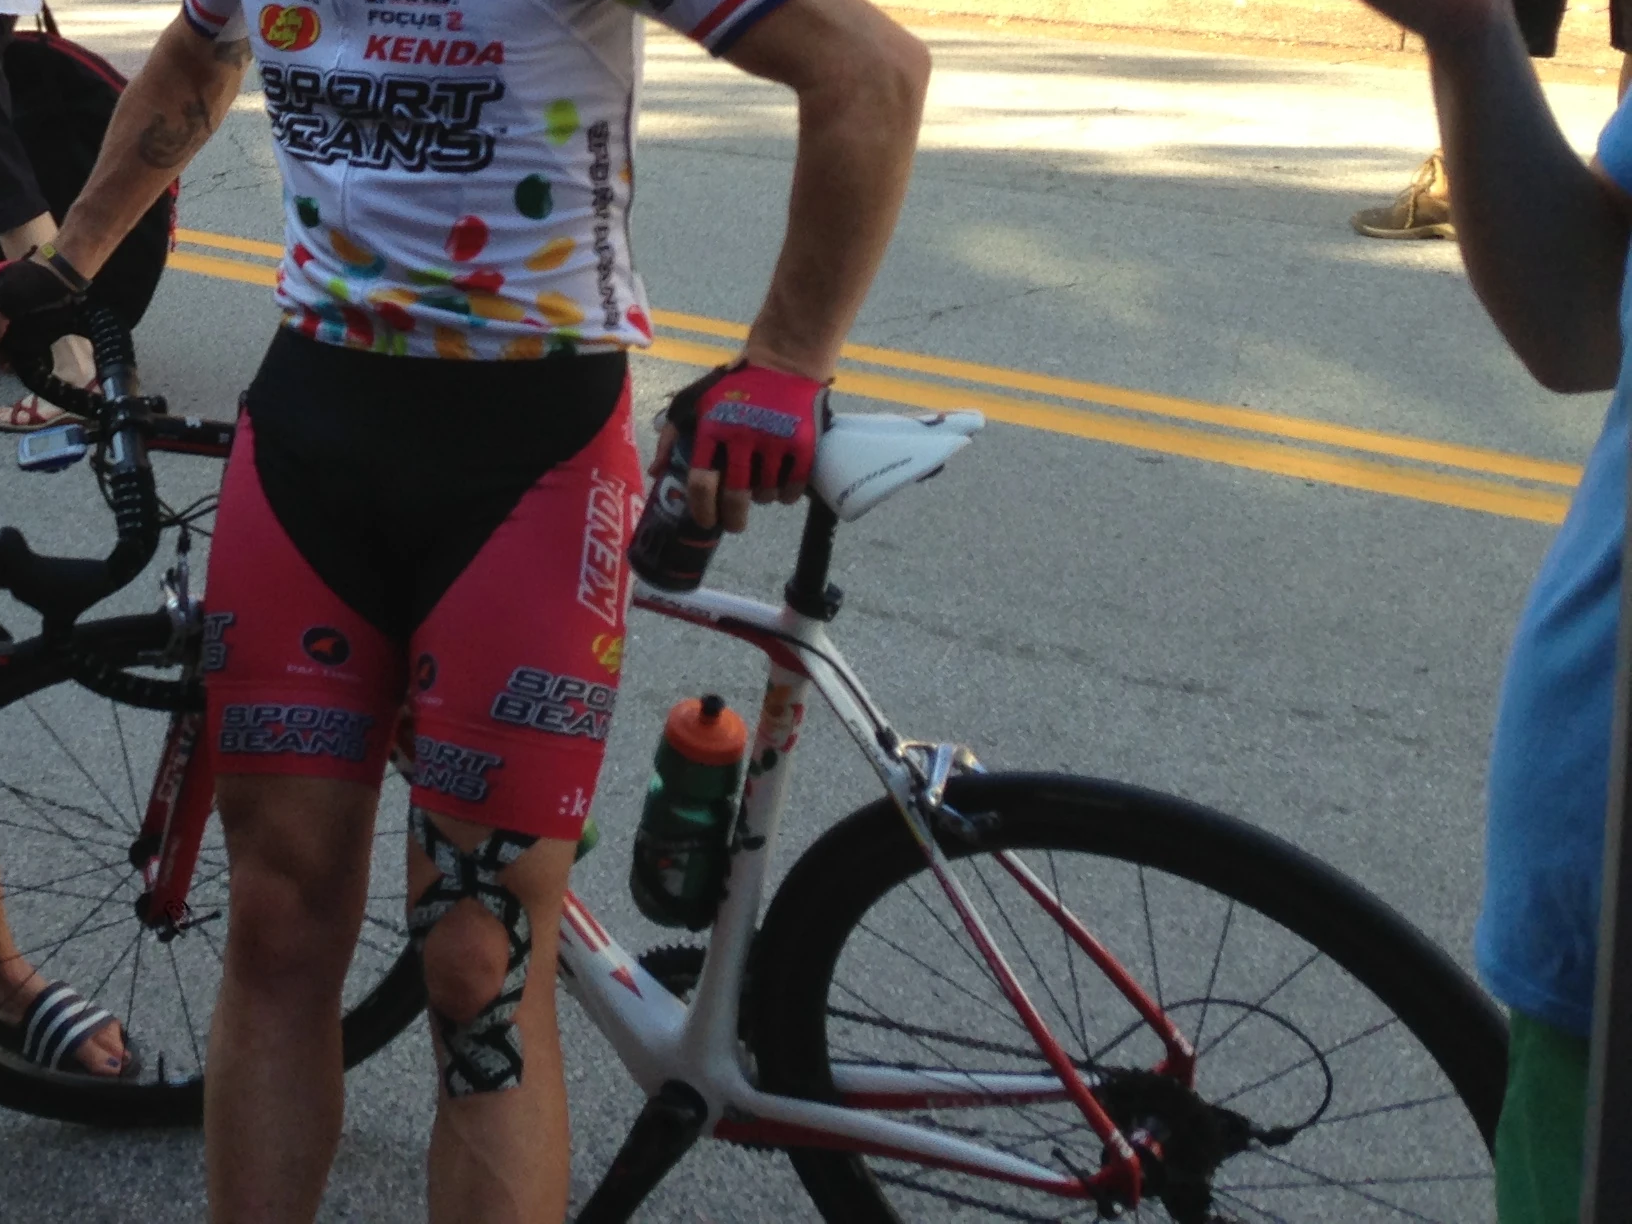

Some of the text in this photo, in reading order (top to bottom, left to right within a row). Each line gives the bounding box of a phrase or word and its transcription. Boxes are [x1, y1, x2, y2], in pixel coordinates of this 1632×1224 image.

[368, 9, 442, 27] FOCUS
[363, 33, 505, 67] KENDA
[260, 61, 506, 128] SPORT
[577, 467, 627, 627] KENDA
[507, 665, 618, 712] SPO
[223, 703, 374, 730] SPORT
[490, 691, 612, 741] BEA
[220, 728, 366, 761] BEANS
[415, 734, 504, 775] ORT
